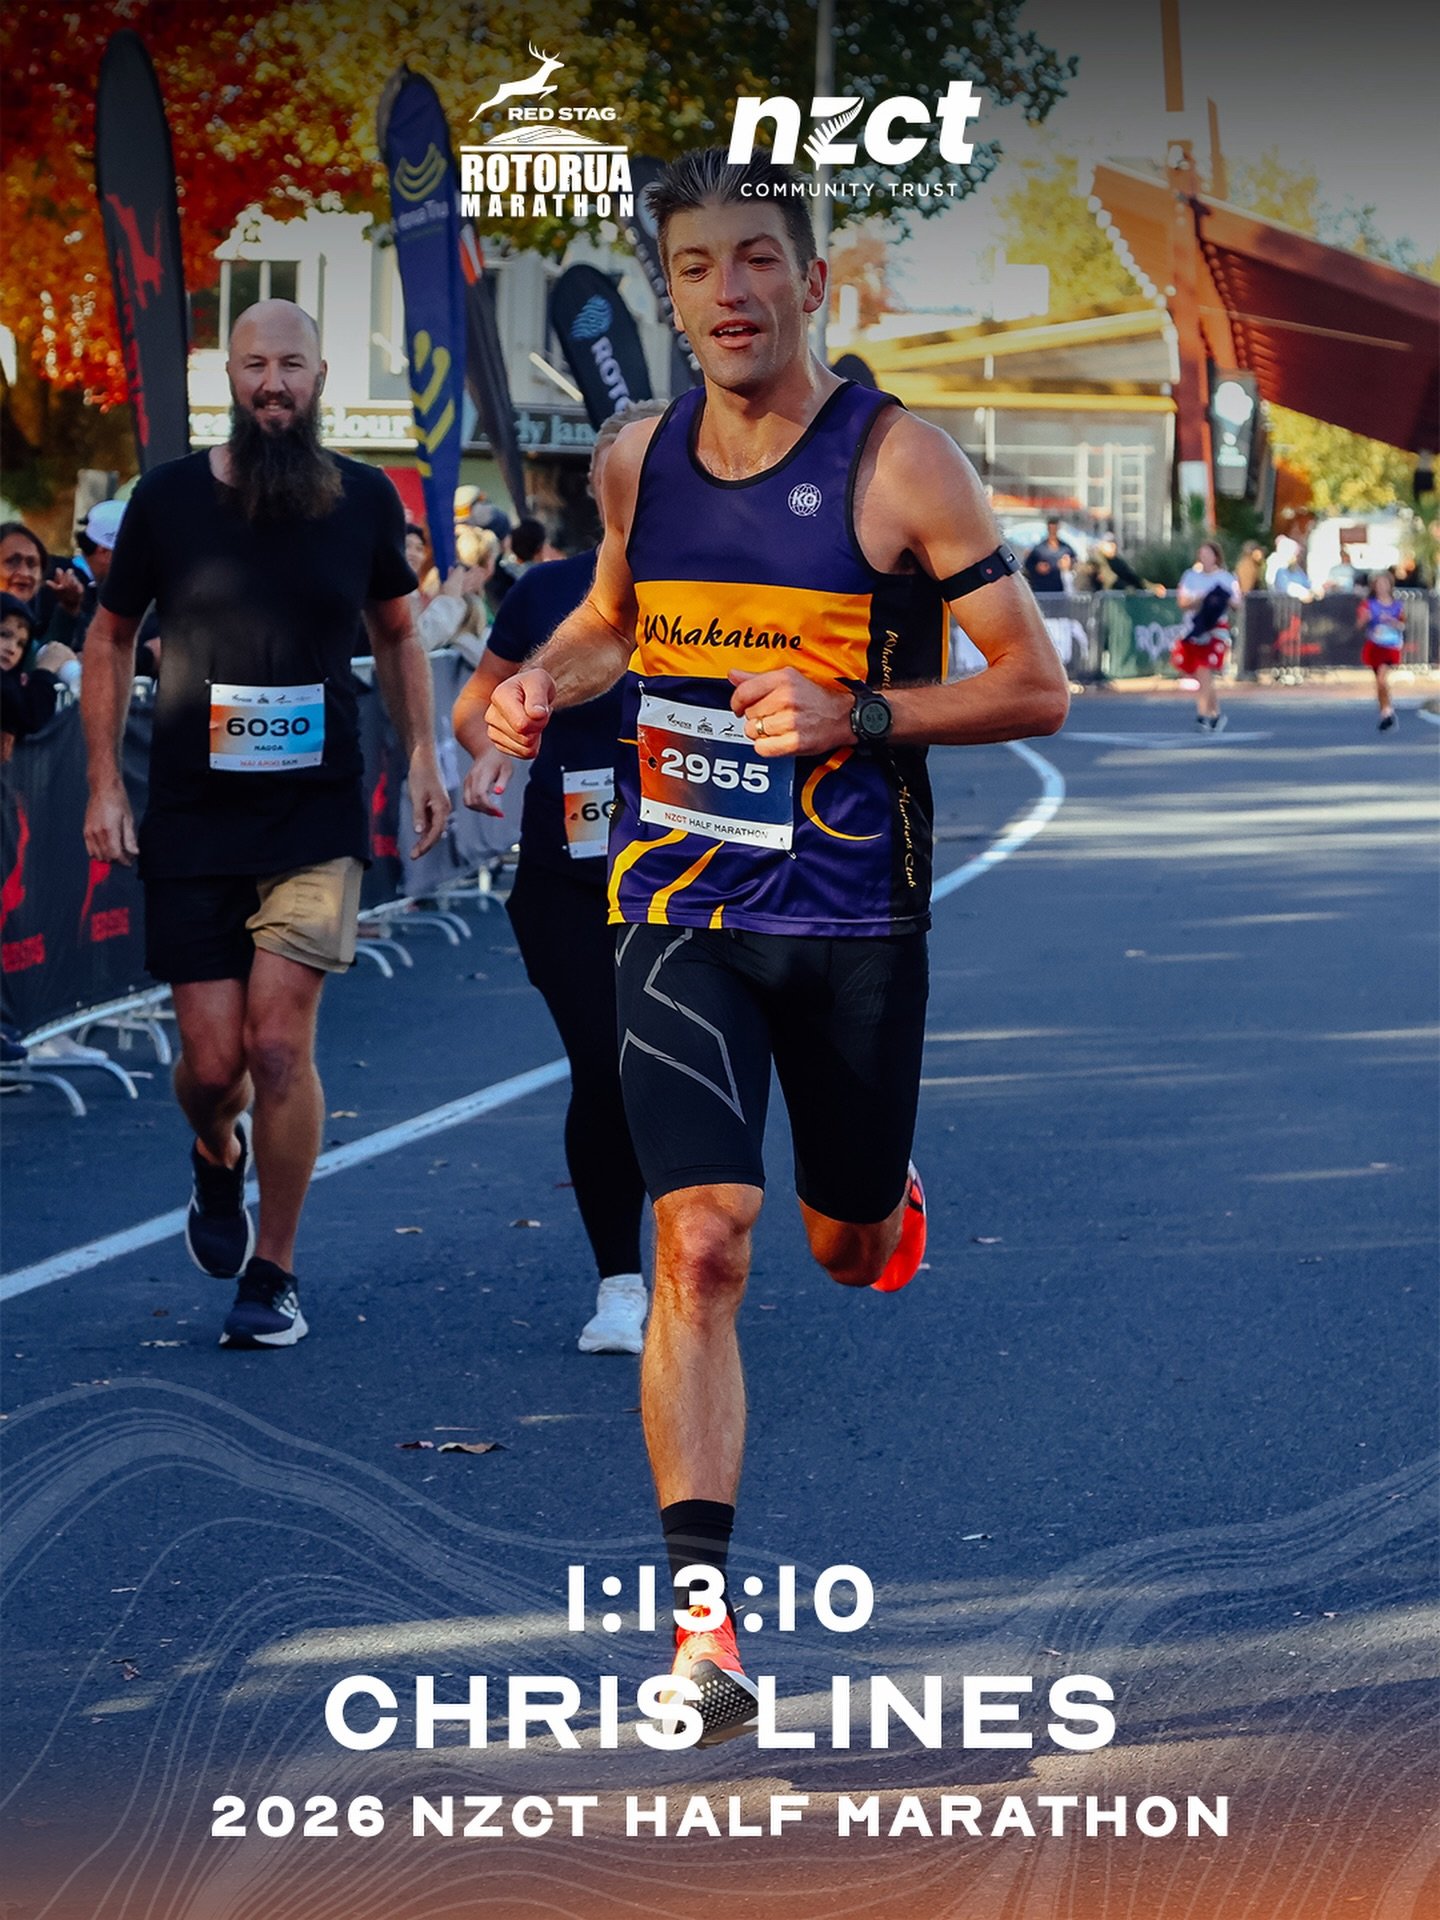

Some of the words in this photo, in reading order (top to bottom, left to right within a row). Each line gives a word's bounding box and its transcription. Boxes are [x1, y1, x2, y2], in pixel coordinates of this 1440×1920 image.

[643, 614, 803, 651] Whakatane
[226, 717, 311, 737] 6030
[660, 747, 771, 794] 2955
[581, 800, 615, 822] 60
[664, 811, 688, 825] NZCT
[688, 817, 713, 830] HALF
[713, 823, 770, 840] MARATHON
